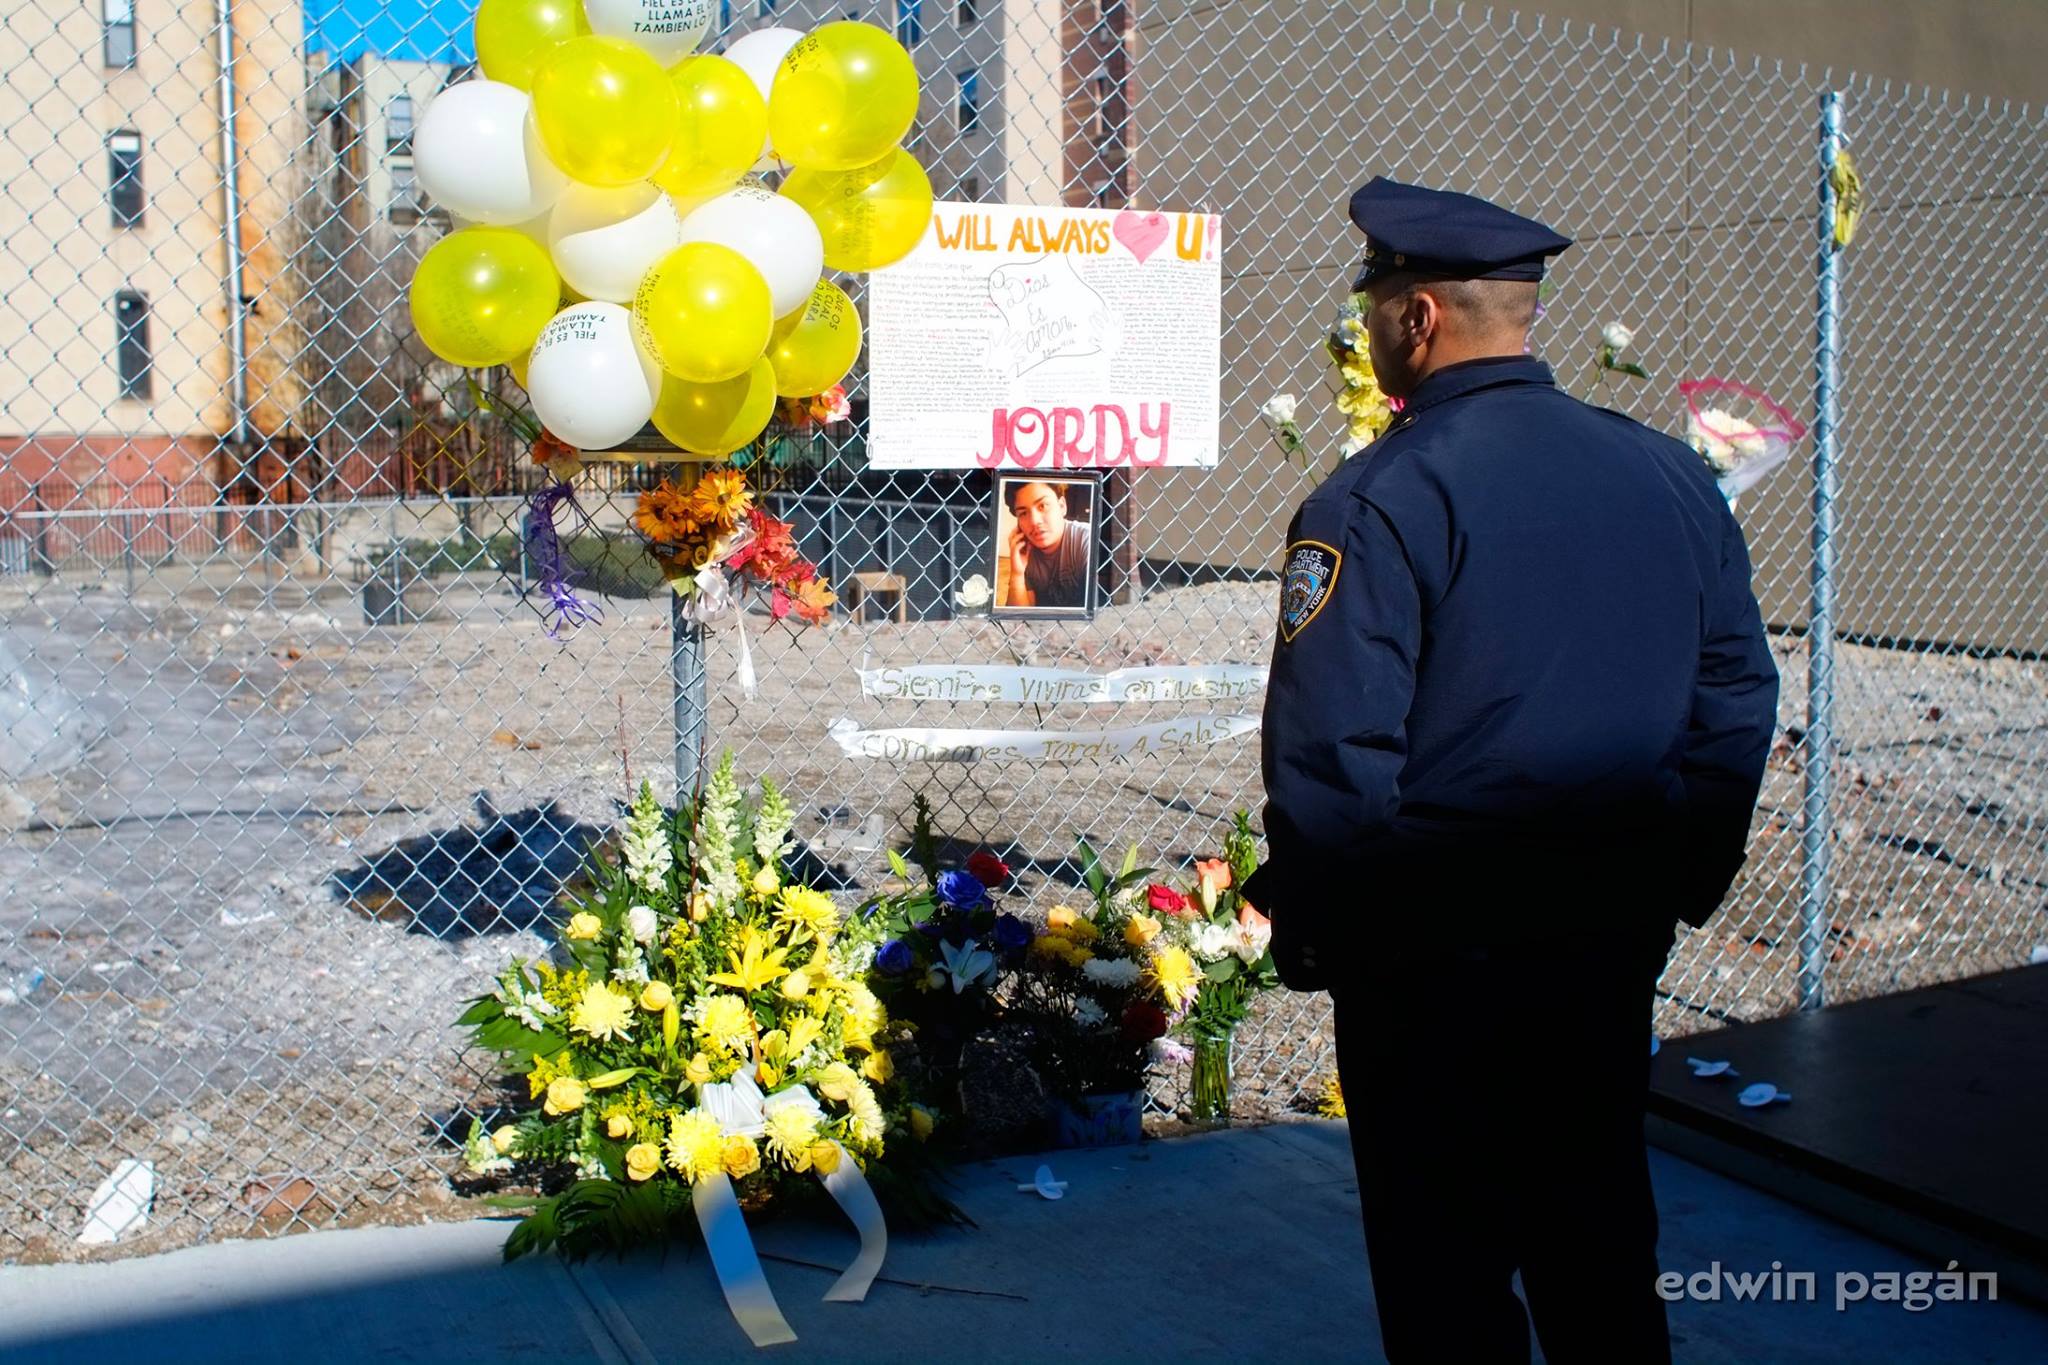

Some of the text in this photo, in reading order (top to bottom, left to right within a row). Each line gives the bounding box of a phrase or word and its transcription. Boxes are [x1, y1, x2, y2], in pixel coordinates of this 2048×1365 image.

[648, 8, 692, 21] LLAMA
[696, 4, 704, 15] EL
[634, 21, 691, 34] TAMBIEN
[934, 213, 997, 251] WILL
[1007, 216, 1111, 255] ALWAYS
[805, 293, 822, 321] HARA
[819, 294, 834, 320] CUAL
[550, 321, 593, 336] LLAMA
[829, 313, 841, 331] OS
[556, 332, 568, 343] ES
[574, 330, 597, 340] FIEL
[975, 402, 1171, 469] JORDY
[1296, 549, 1324, 563] POLICE
[1294, 586, 1328, 627] NEW YORK
[1124, 680, 1155, 698] en
[1161, 671, 1261, 698] nuestros
[1127, 735, 1148, 754] A
